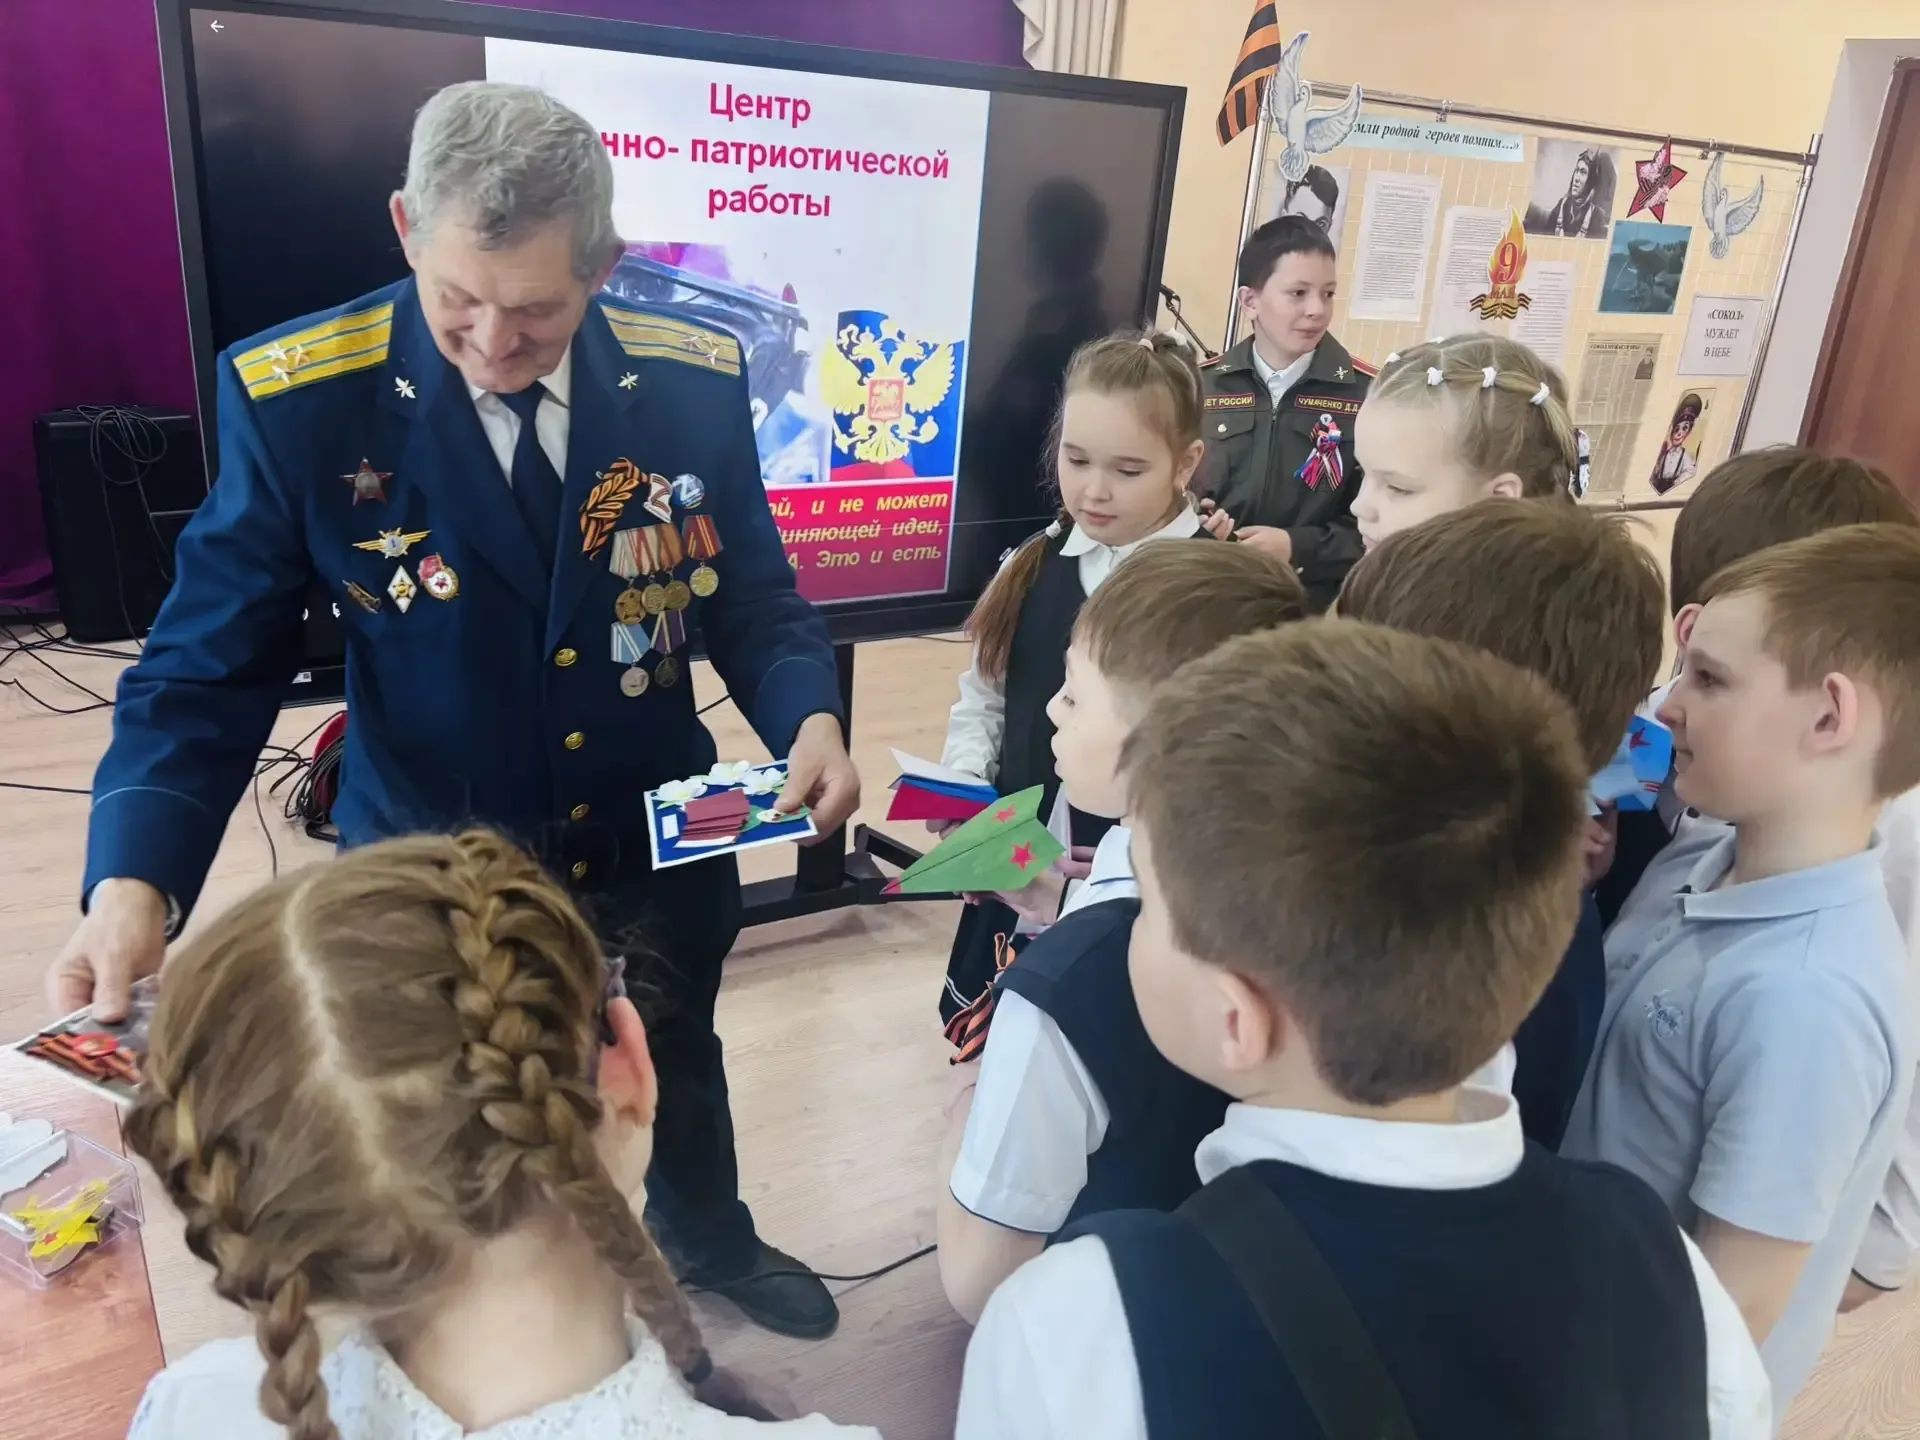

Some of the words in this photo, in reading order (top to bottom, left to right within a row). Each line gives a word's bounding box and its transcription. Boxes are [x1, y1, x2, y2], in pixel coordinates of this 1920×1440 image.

[710, 83, 811, 128] Центр
[1354, 123, 1380, 135] мли
[1381, 124, 1420, 139] родной
[1425, 129, 1461, 145] героев
[691, 138, 949, 179] патриотической
[708, 184, 830, 218] работы
[1497, 243, 1518, 284] 9
[1707, 309, 1744, 321] «СОКОЛ»
[1704, 328, 1740, 339] МУЖАЕТ
[1704, 347, 1710, 357] В
[1711, 347, 1731, 357] НЕБЕ
[1204, 398, 1217, 407] ЕТ
[1219, 396, 1252, 406] РОССИИ
[1298, 398, 1342, 409] ЧУМАЧЕНКО
[811, 499, 824, 515] и
[839, 498, 864, 513] не
[876, 493, 948, 511] может
[777, 519, 880, 545] иняющей
[892, 517, 943, 537] идеи,
[816, 549, 860, 568] Это
[870, 550, 882, 564] и
[892, 544, 941, 561] есть
